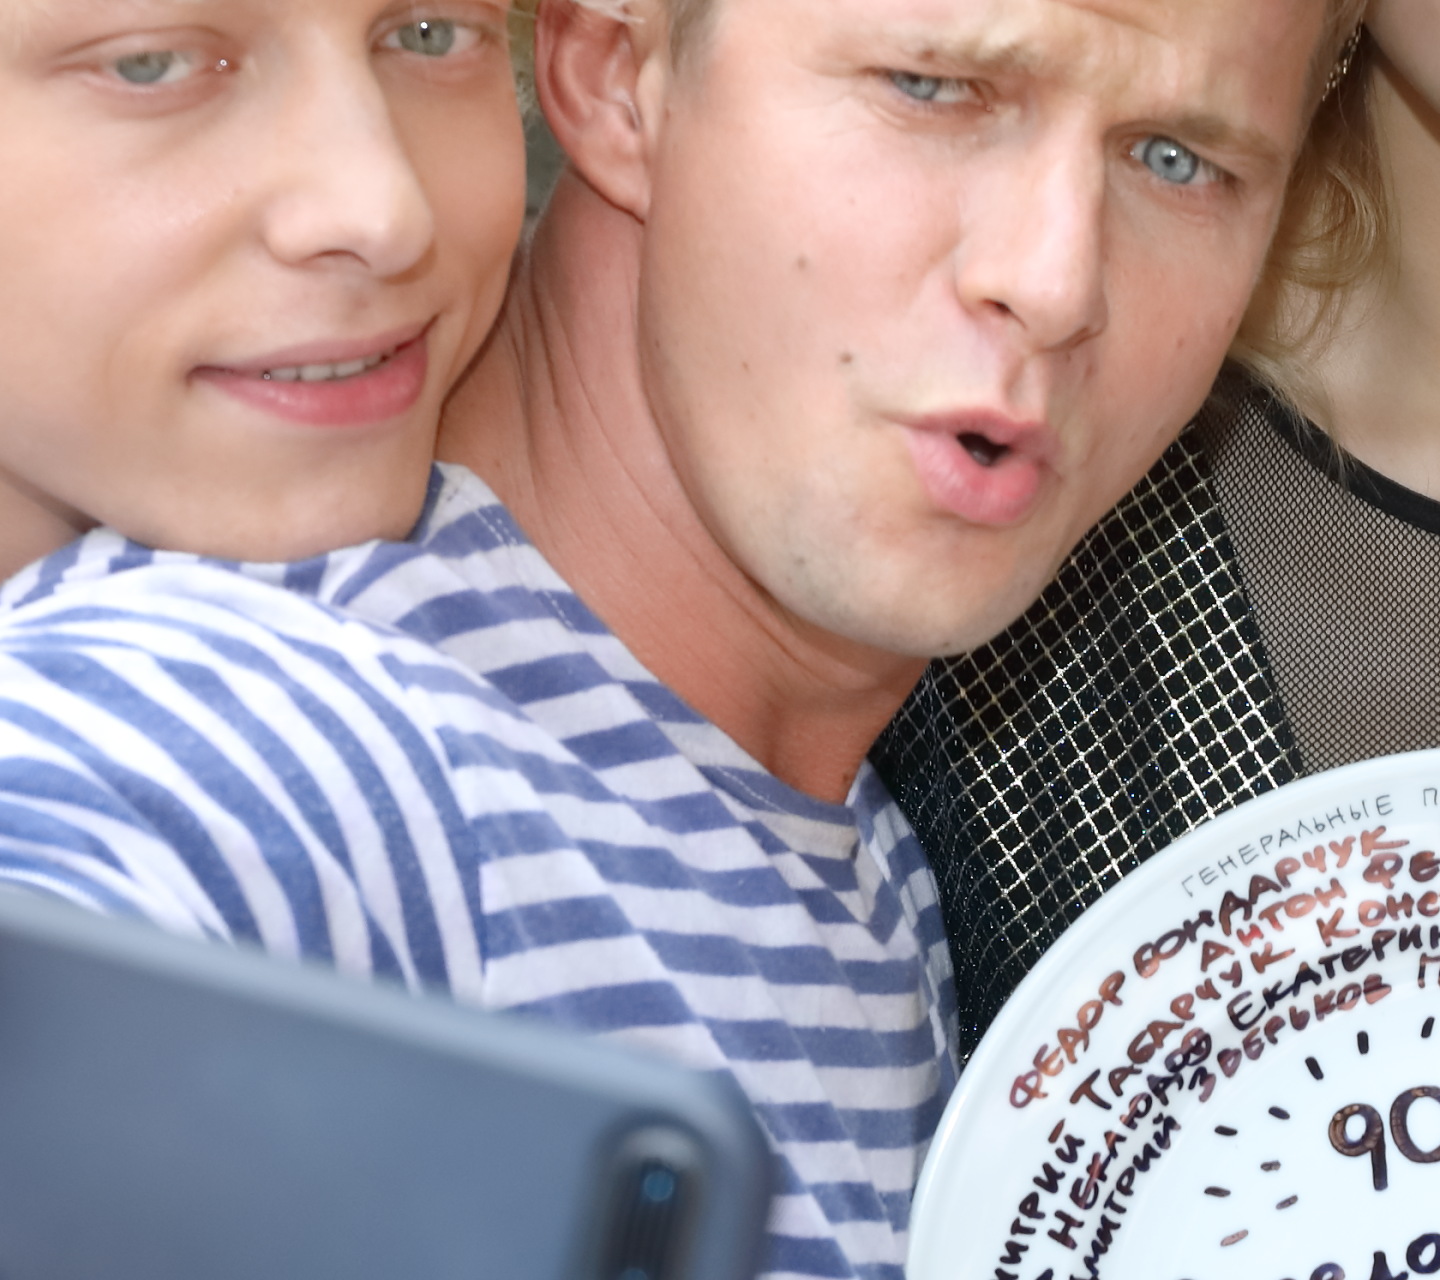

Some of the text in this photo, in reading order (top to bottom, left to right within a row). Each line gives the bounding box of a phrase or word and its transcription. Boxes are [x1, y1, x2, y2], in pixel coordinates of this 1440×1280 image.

[1180, 793, 1394, 898] ГЕНЕРАЛЬНЫЕ
[1009, 970, 1126, 1109] ФЕДОР
[1133, 825, 1410, 979] БОНДАРЧУК
[1198, 878, 1348, 973] АНТОН
[1069, 941, 1296, 1110] ТАБАРЧУК
